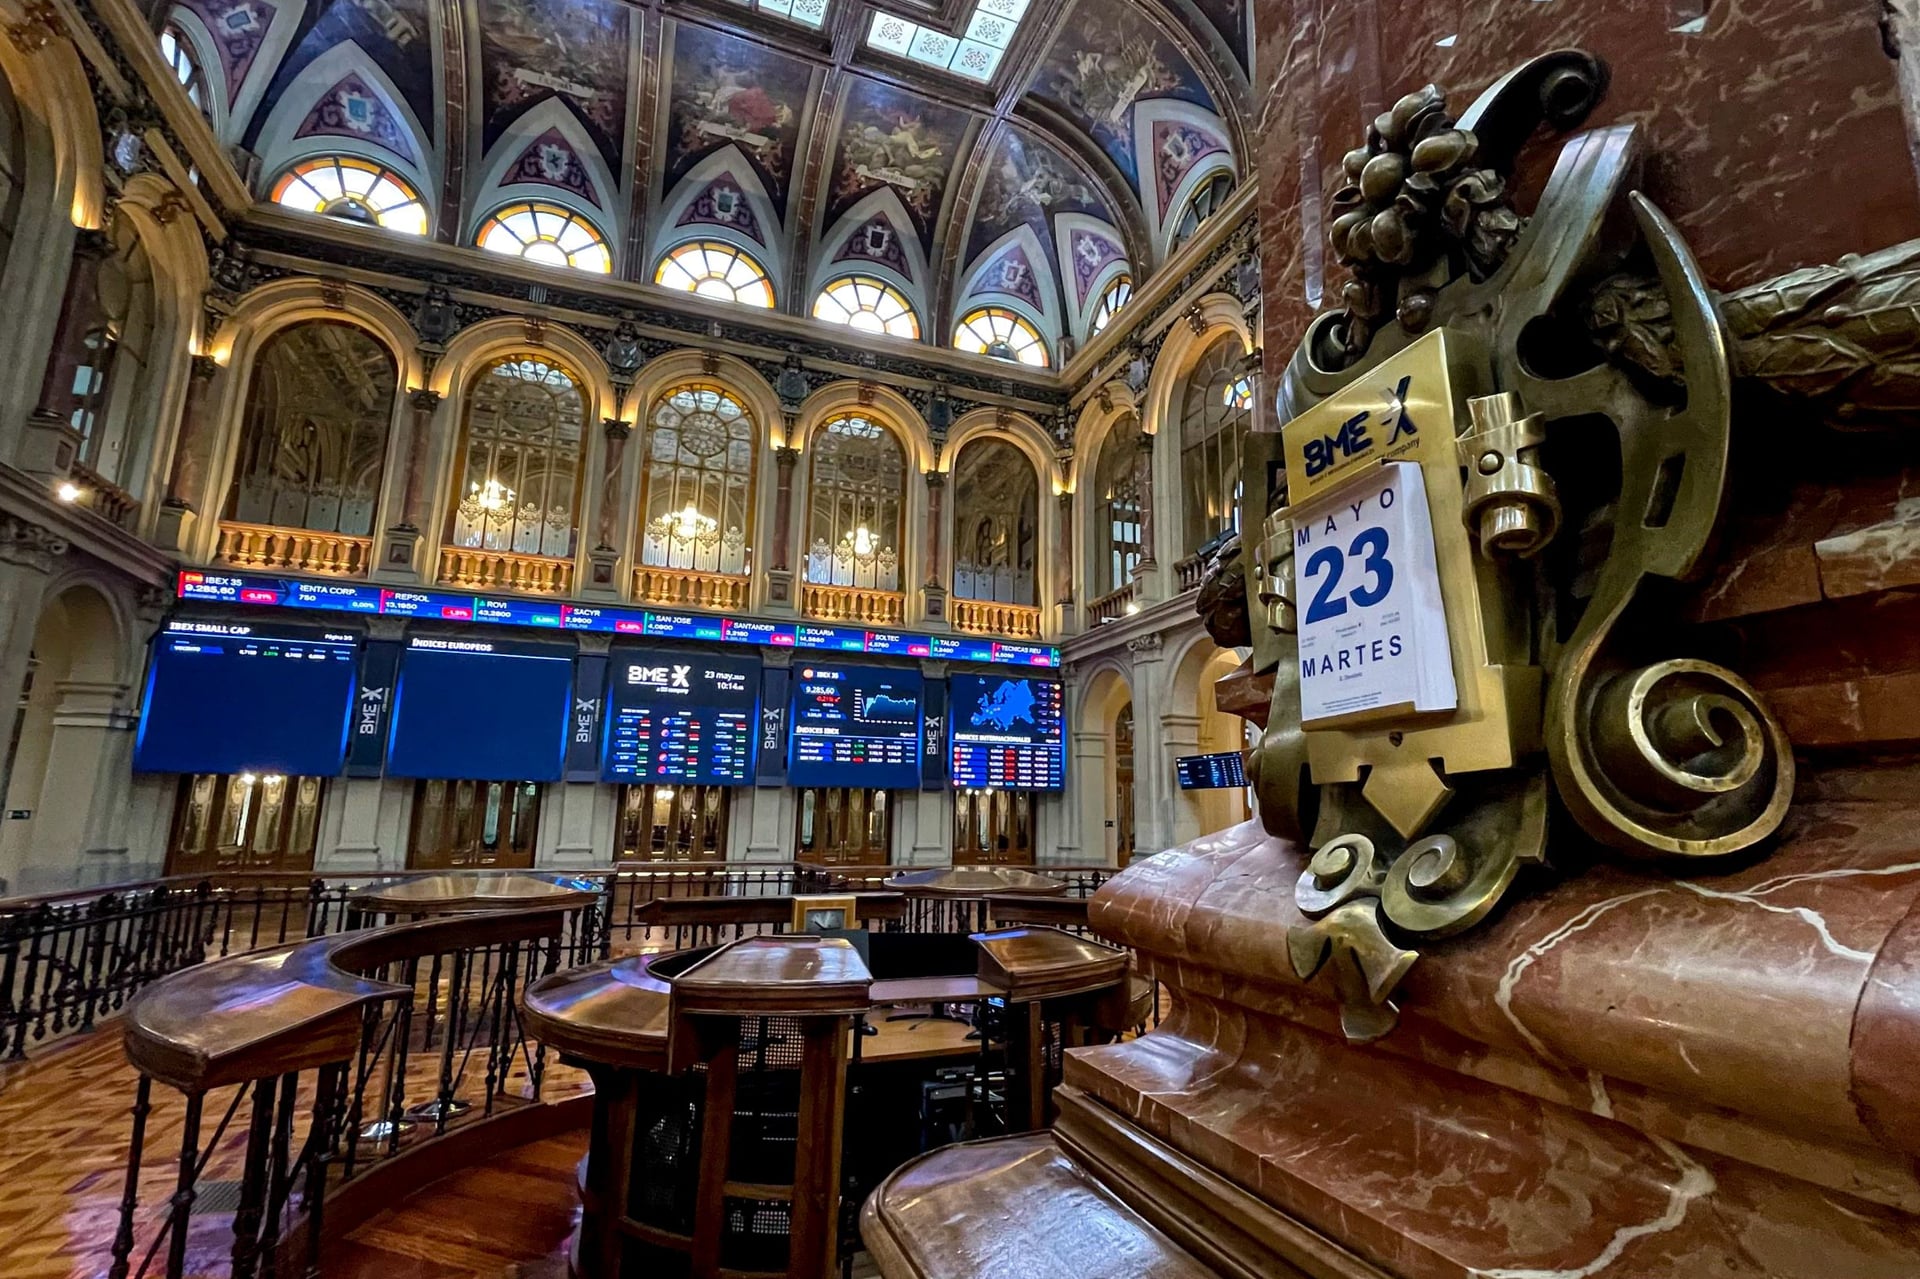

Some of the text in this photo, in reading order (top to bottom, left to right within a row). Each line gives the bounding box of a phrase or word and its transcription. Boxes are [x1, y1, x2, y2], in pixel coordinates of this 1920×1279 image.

[1303, 410, 1373, 477] BME
[1297, 487, 1394, 547] MAYO
[205, 576, 242, 587] IBEX 35
[1304, 526, 1394, 625] 23
[329, 587, 358, 596] CORP.
[394, 592, 430, 602] REPSOL
[486, 600, 507, 609] ROVI
[573, 608, 601, 617] SACYR
[655, 615, 692, 625] SAN JOSE
[169, 622, 250, 635] IBEX SMALL CAP
[733, 622, 775, 632] SANTANDER
[806, 628, 835, 637] SOLARIA
[875, 633, 900, 643] SOLTEC
[939, 639, 960, 648] TALGO
[411, 637, 493, 652] ÍNDICES EUROPEOS
[1302, 635, 1402, 679] MARTES
[627, 665, 669, 682] BME
[704, 670, 715, 679] 23
[360, 703, 377, 734] BME
[575, 714, 590, 743] BME
[764, 722, 776, 749] BME
[926, 730, 937, 755] BME
